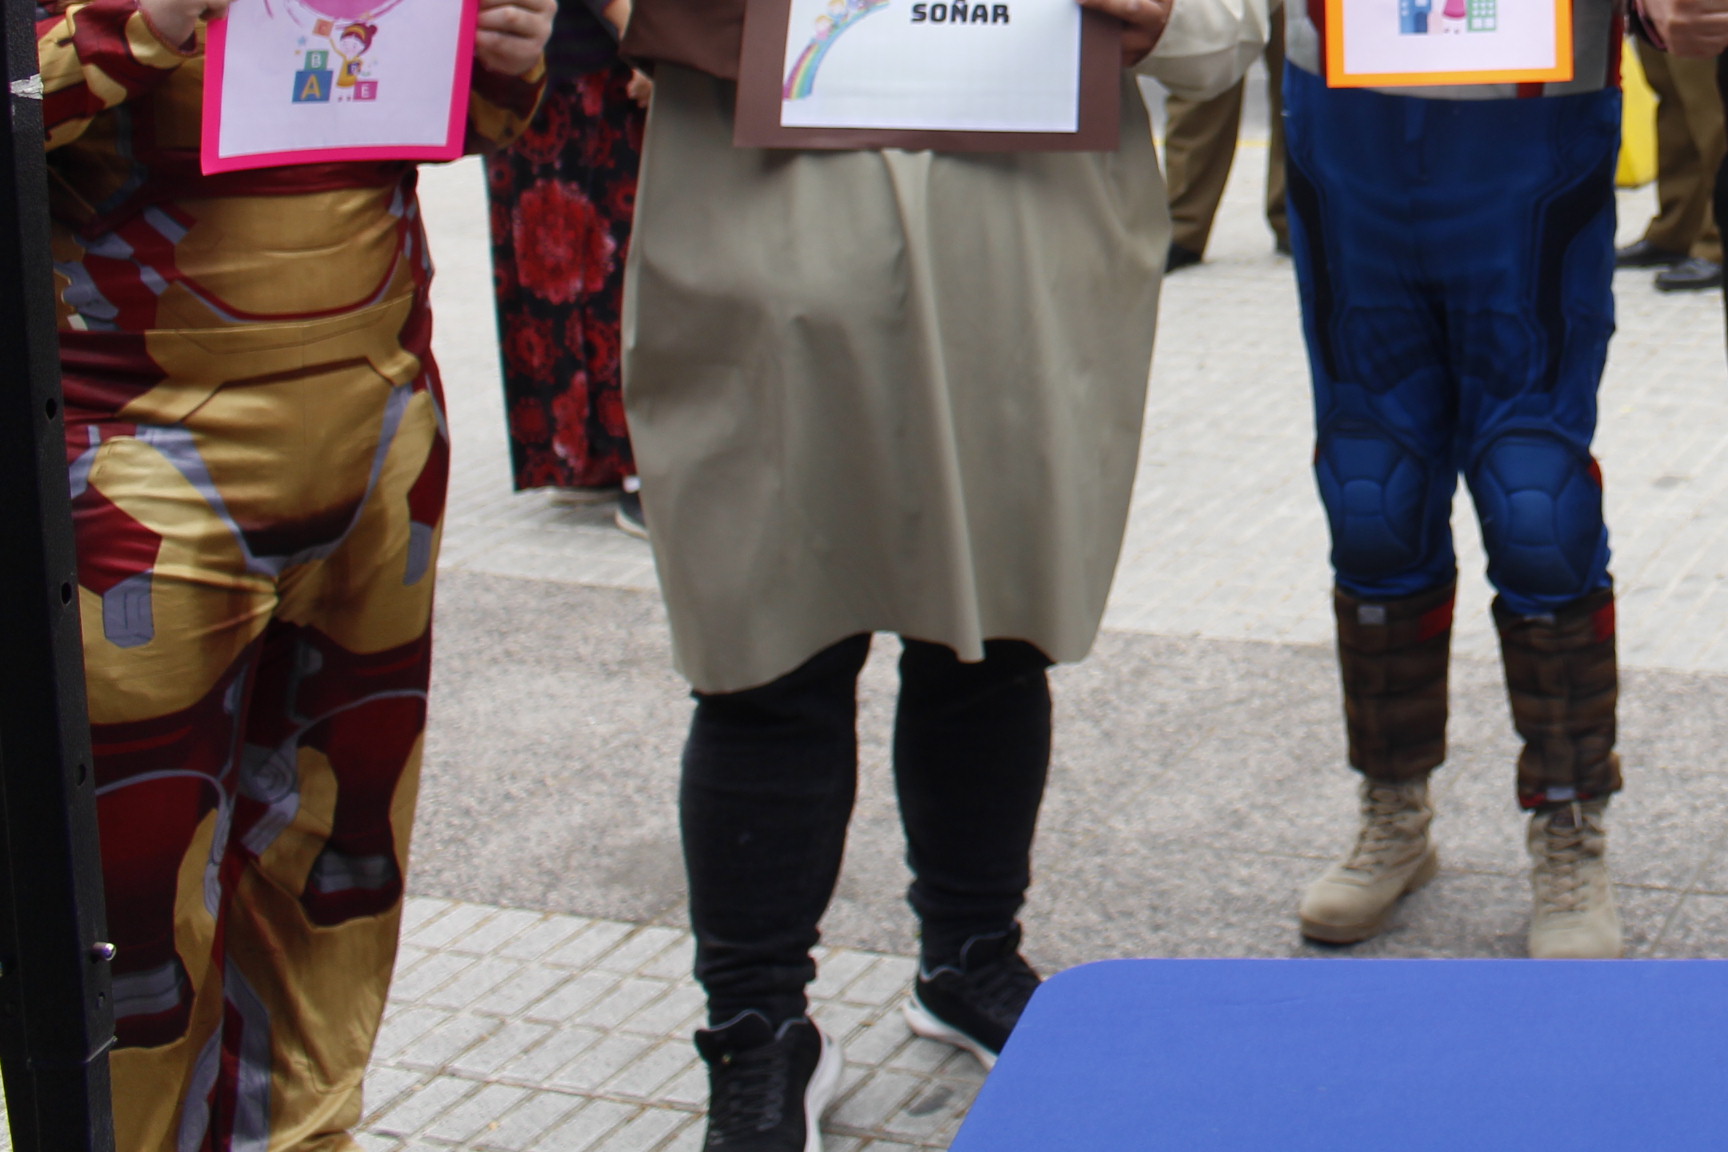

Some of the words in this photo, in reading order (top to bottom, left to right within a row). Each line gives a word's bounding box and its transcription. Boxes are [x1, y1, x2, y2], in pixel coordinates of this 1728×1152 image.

[310, 53, 322, 68] B
[300, 74, 322, 100] A
[360, 85, 370, 98] E
